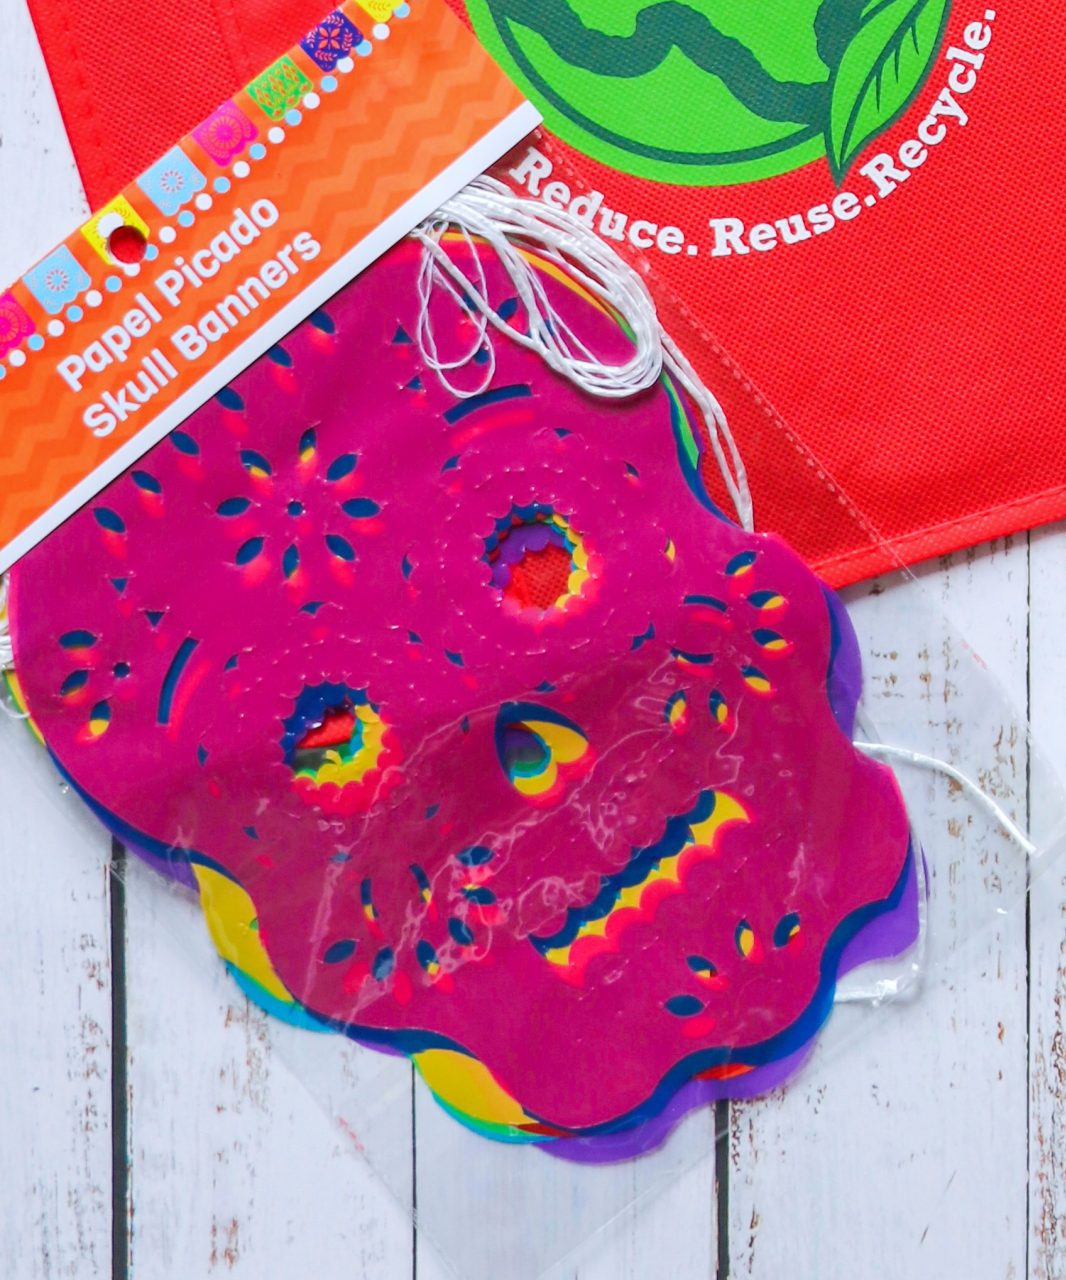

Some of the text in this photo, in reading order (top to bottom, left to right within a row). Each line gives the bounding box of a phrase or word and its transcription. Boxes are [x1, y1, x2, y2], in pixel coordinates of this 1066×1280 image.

[508, 7, 998, 258] Reduce. Reuse. Recycle.
[56, 197, 280, 395] Papel Picado
[83, 230, 323, 440] Skull Banners
